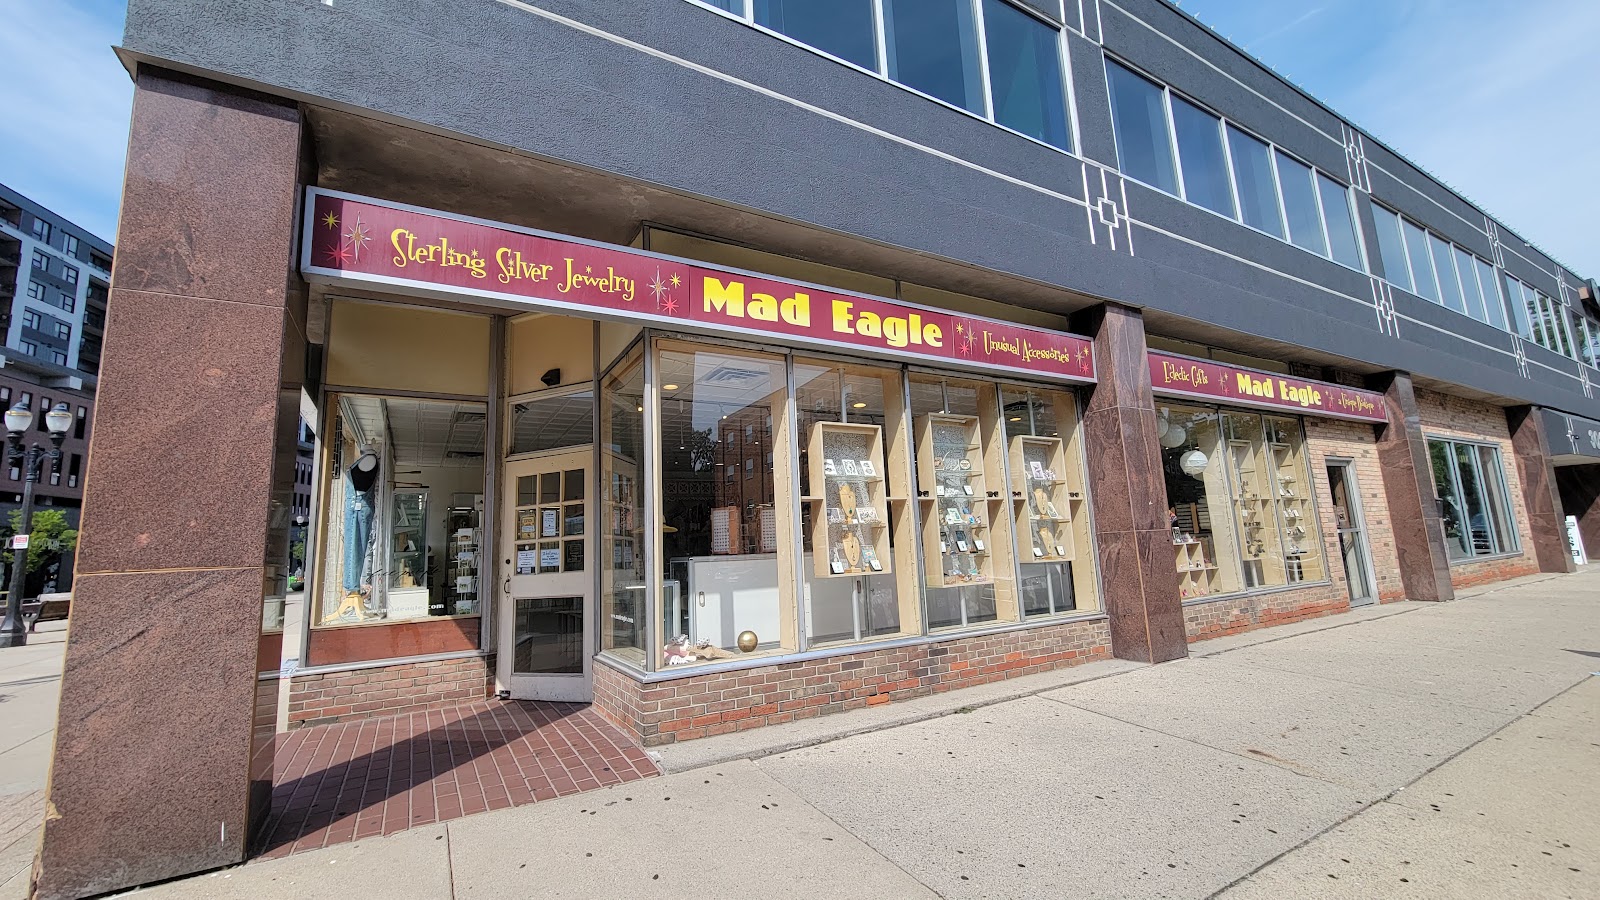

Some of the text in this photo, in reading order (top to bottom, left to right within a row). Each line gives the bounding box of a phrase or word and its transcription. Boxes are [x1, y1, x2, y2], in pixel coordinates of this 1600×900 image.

[390, 228, 635, 301] Sterling Silver Jewelry
[703, 276, 943, 348] Mad Eagle
[982, 330, 1070, 363] Unusual Accessories
[1162, 361, 1209, 388] Eclectic Gifts
[1236, 372, 1322, 407] Mad Eagle
